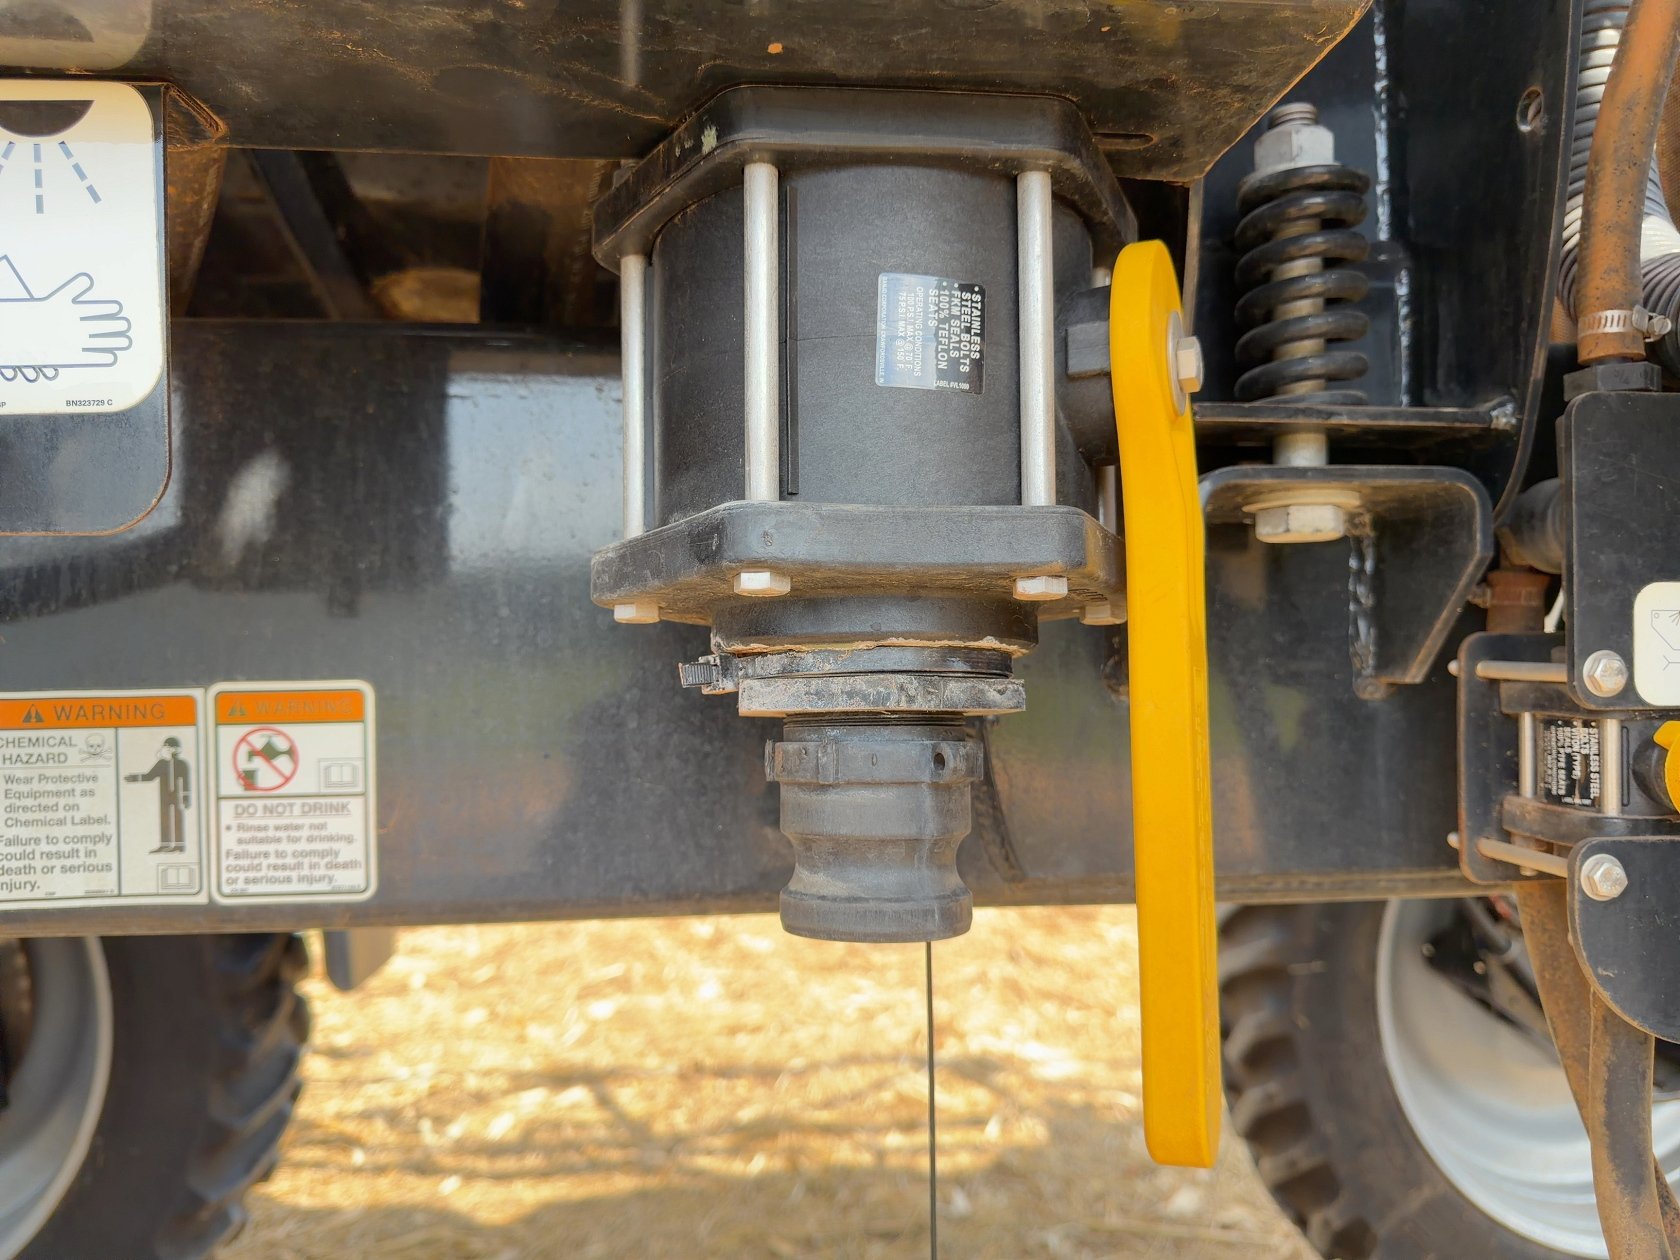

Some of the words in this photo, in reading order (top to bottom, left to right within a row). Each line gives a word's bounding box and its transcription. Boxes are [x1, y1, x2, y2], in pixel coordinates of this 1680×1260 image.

[898, 291, 906, 300] 75
[907, 293, 915, 304] 100
[951, 290, 961, 315] FKM
[915, 286, 924, 329] OPERATING
[928, 288, 938, 327] SEATS
[939, 290, 950, 318] 100%
[960, 292, 971, 329] STEEL
[897, 321, 905, 337] MAX
[905, 325, 914, 342] MAX
[970, 294, 981, 359] STAINLESS
[938, 323, 949, 370] TEFLON
[950, 320, 960, 358] SEALS
[913, 330, 923, 377] CONDITIONS
[960, 334, 971, 373] BOLTS
[53, 704, 167, 721] WARNING
[1580, 727, 1590, 754] BOLTS
[1589, 728, 1600, 772] STAINLESS
[2, 752, 68, 765] HAZARD
[4, 775, 35, 786] Wear
[38, 773, 99, 785] Protective
[1590, 773, 1600, 799] STEEL
[4, 788, 77, 801] Equipment
[80, 789, 96, 798] as
[4, 801, 59, 814] directed
[63, 803, 80, 812] on
[234, 804, 257, 817] DO
[262, 803, 297, 816] NOT
[301, 801, 351, 815] DRINK
[4, 816, 67, 829] Chemical
[71, 815, 111, 827] Label.
[236, 822, 270, 833] Rinse
[273, 822, 305, 832] water
[309, 821, 328, 831] not
[46, 834, 60, 846] to
[63, 833, 113, 848] comply
[236, 832, 283, 844] suitable
[286, 832, 303, 843] for
[40, 847, 80, 860] result
[84, 847, 97, 859] in
[225, 849, 271, 861] Failure
[274, 848, 288, 859] to
[292, 846, 341, 861] comply
[41, 865, 57, 875] or
[60, 862, 113, 874] serious
[225, 860, 263, 873] could
[267, 859, 305, 872] result
[308, 859, 321, 870] in
[325, 857, 362, 869] death
[0, 879, 41, 893] njury.
[225, 875, 240, 885] or
[243, 873, 293, 885] serious
[296, 871, 338, 886] injury.
